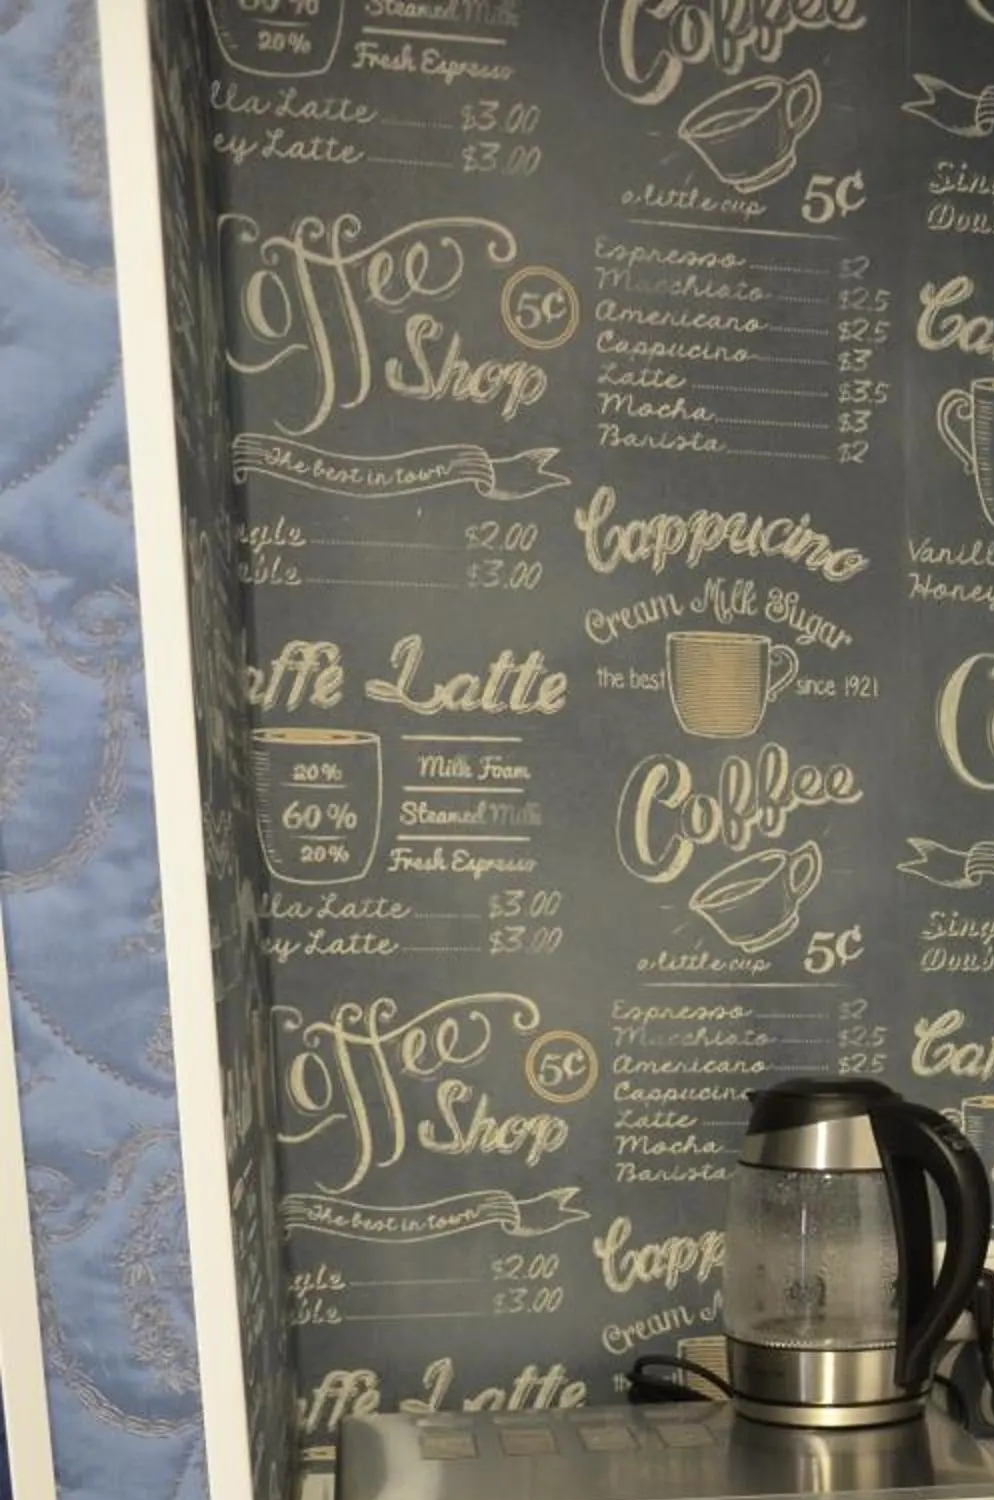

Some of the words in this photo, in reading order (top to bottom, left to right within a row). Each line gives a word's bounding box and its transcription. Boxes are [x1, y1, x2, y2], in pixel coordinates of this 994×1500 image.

[257, 30, 312, 54] 20%
[351, 42, 417, 73] Fresh
[421, 49, 516, 85] Espresso
[277, 86, 378, 124] Latte
[261, 128, 366, 164] Latte
[800, 169, 867, 224] 5¢
[594, 235, 746, 268] Espresso
[514, 289, 567, 329] 5¢
[594, 299, 769, 333] Americano
[384, 313, 548, 419] Shop
[596, 362, 688, 390] Latte
[838, 347, 874, 373] $3
[596, 391, 717, 423] Mocha
[838, 408, 874, 433] $3
[598, 422, 728, 454] Barista
[584, 592, 686, 645] Cream
[764, 586, 853, 651] Sugar
[364, 633, 568, 715] Latte
[596, 666, 628, 690] the
[630, 668, 667, 691] best
[796, 675, 836, 698] since
[845, 674, 880, 698] 1921
[476, 754, 531, 781] Foam
[281, 801, 359, 832] 60%
[616, 741, 865, 884] Coffee
[300, 845, 351, 864] 20%
[387, 845, 447, 874] Fresh
[450, 848, 538, 880] Espresso
[315, 891, 413, 920] Latte
[304, 926, 400, 957] Latte
[803, 922, 866, 974] 5¢
[611, 998, 752, 1024] Espresso
[537, 1048, 587, 1088] 5¢
[612, 1053, 774, 1075] Americano
[417, 1077, 569, 1168] Shop
[613, 1111, 699, 1130] Latte
[614, 1134, 724, 1156] Mocha
[615, 1161, 737, 1183] Barista
[601, 1305, 696, 1356] Cream
